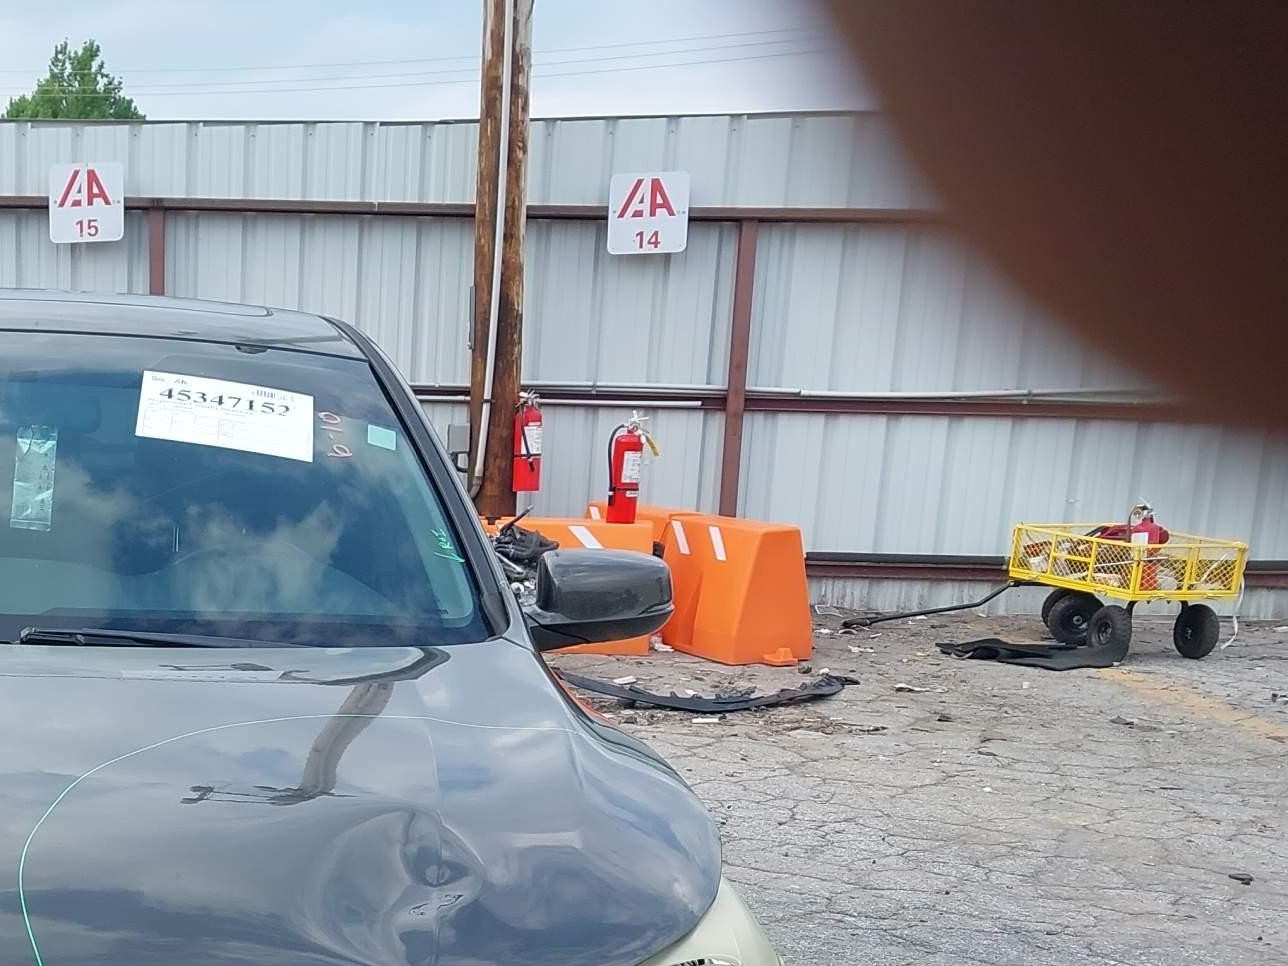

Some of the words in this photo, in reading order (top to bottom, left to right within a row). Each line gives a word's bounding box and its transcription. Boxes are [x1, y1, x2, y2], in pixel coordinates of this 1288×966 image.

[75, 219, 99, 238] 15
[635, 229, 662, 250] 14
[159, 388, 291, 416] 45347152
